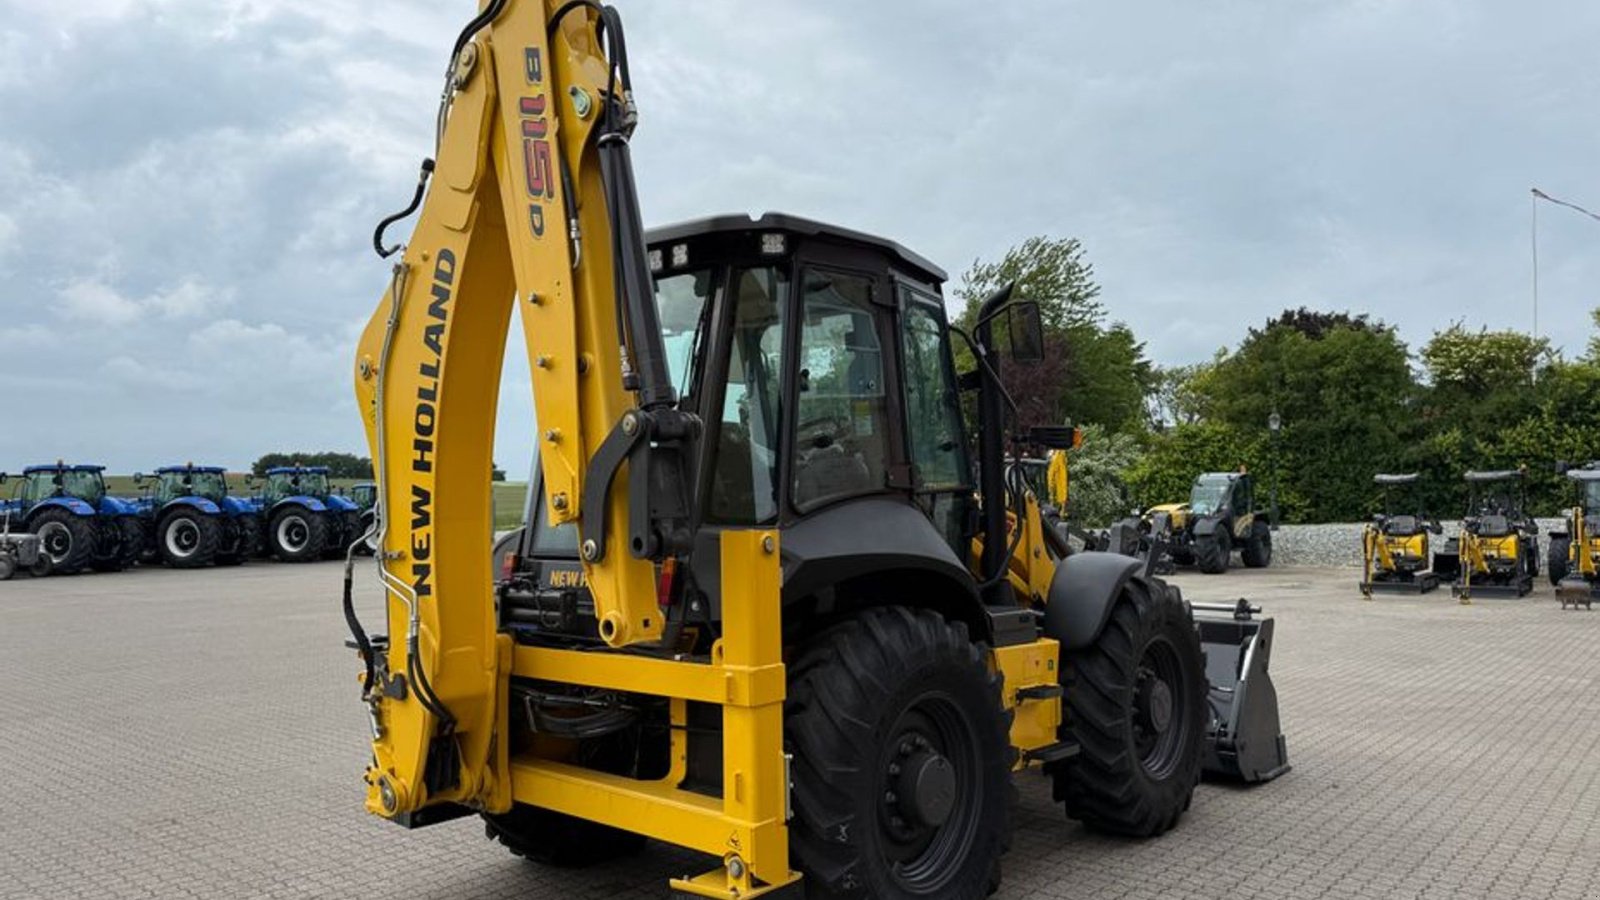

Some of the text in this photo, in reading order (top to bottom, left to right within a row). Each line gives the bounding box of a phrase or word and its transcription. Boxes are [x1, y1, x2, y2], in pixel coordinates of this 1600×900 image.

[411, 248, 456, 596] NEW HOLLAND
[550, 570, 580, 587] NEW
